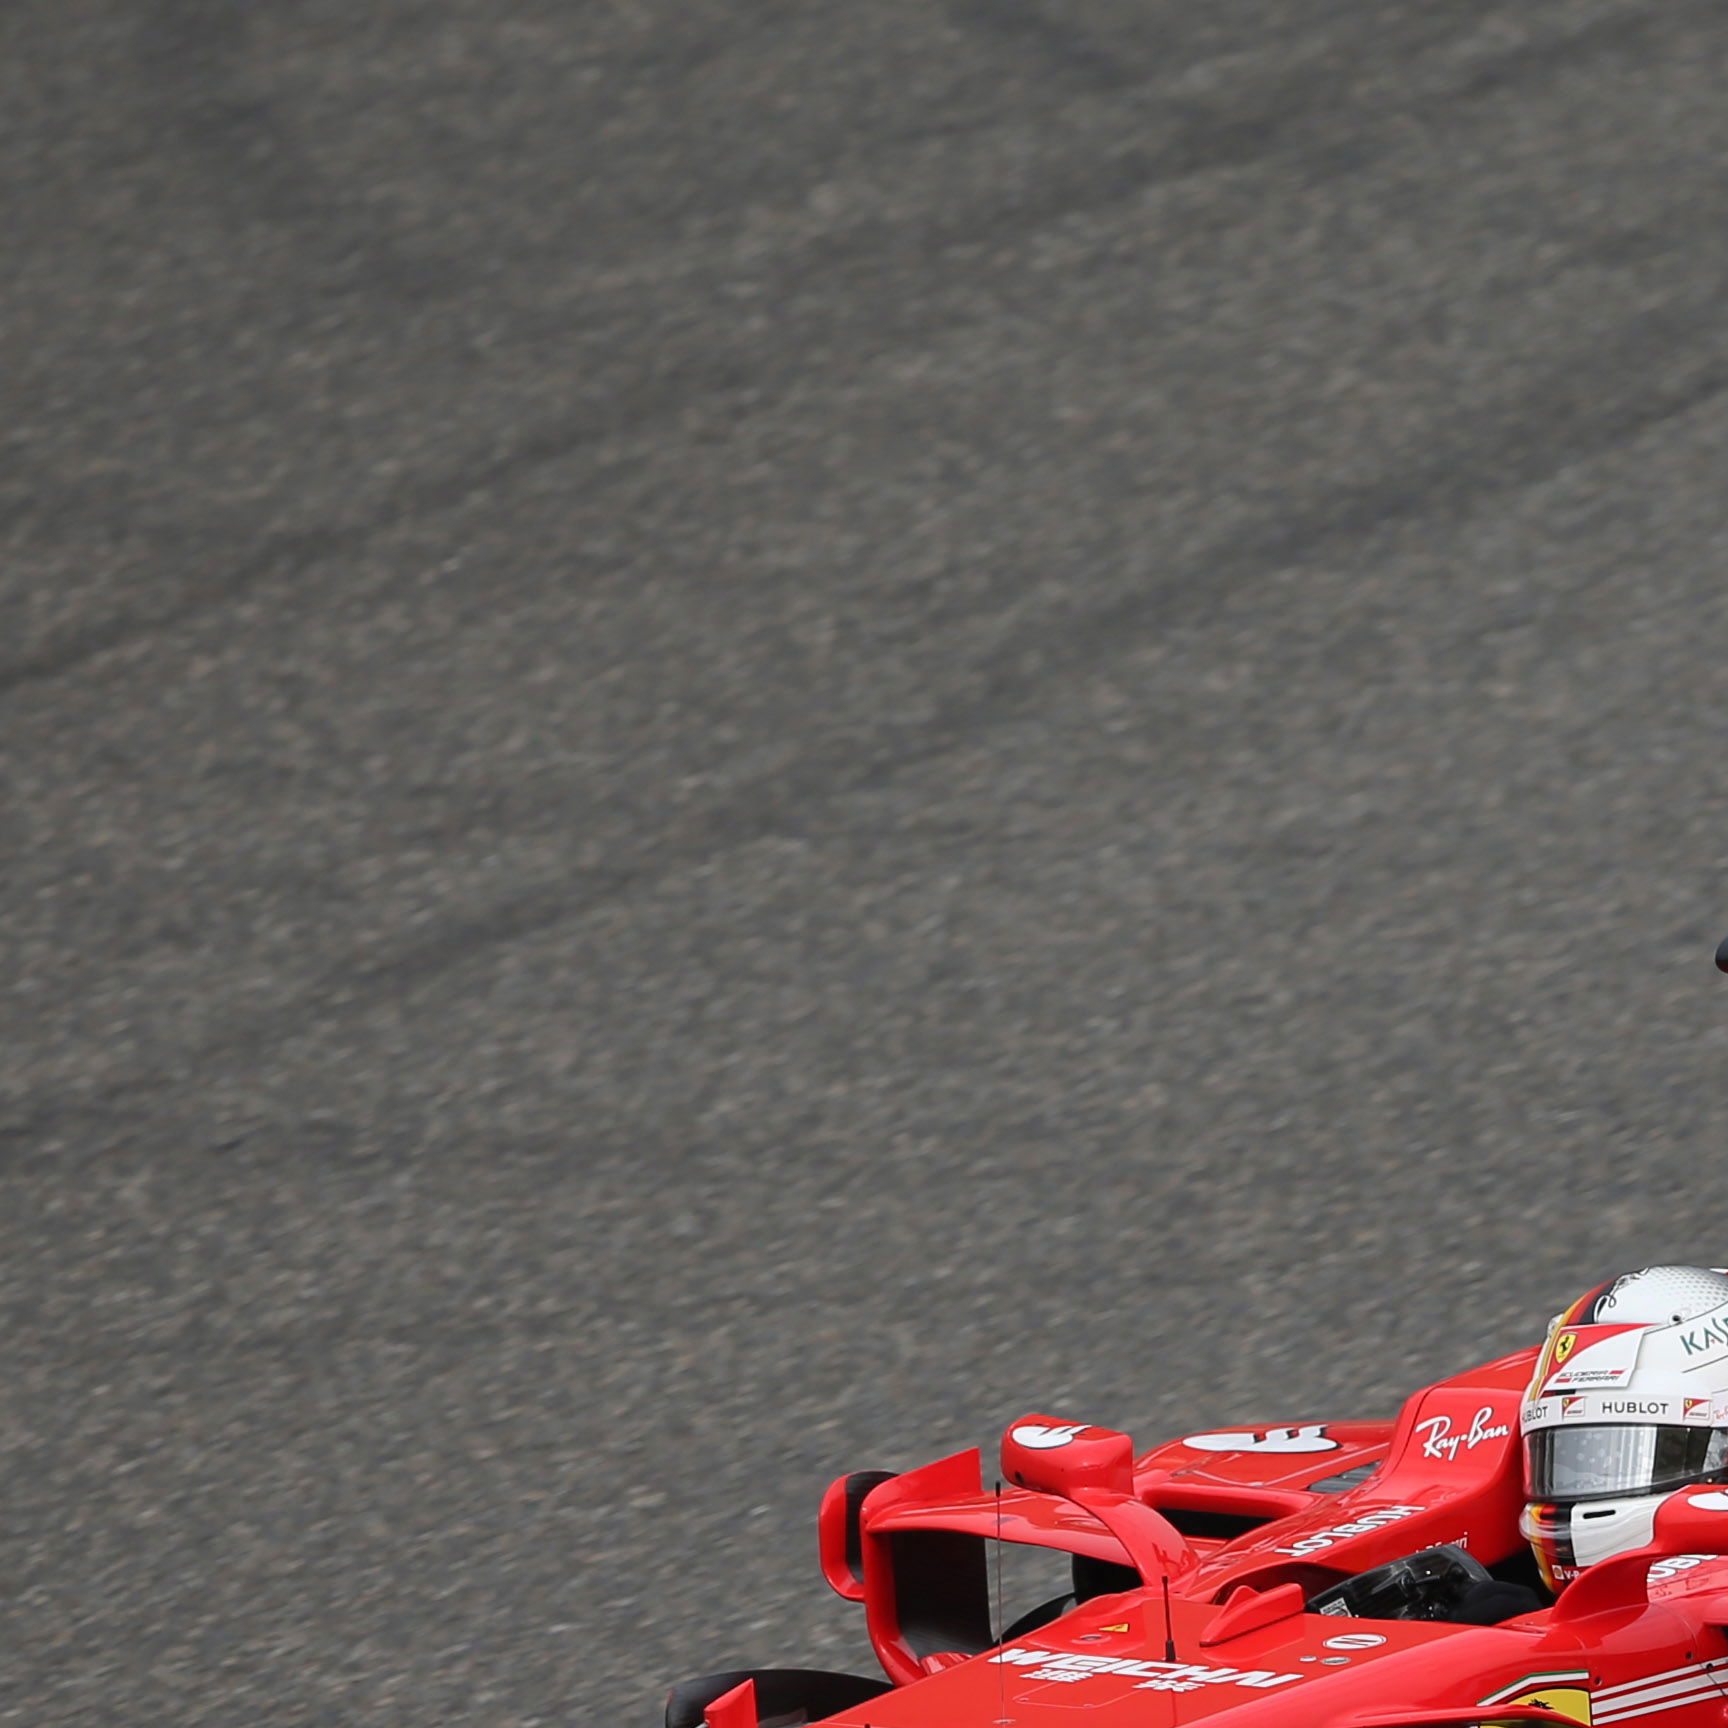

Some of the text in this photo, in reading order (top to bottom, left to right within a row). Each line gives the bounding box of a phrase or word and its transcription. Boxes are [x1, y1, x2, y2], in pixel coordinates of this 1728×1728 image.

[1602, 1402, 1670, 1415] HUBLOT
[1415, 1406, 1510, 1461] Ray-Ban
[1275, 1505, 1427, 1557] HUBLOT
[987, 1648, 1304, 1688] WEICHAI
